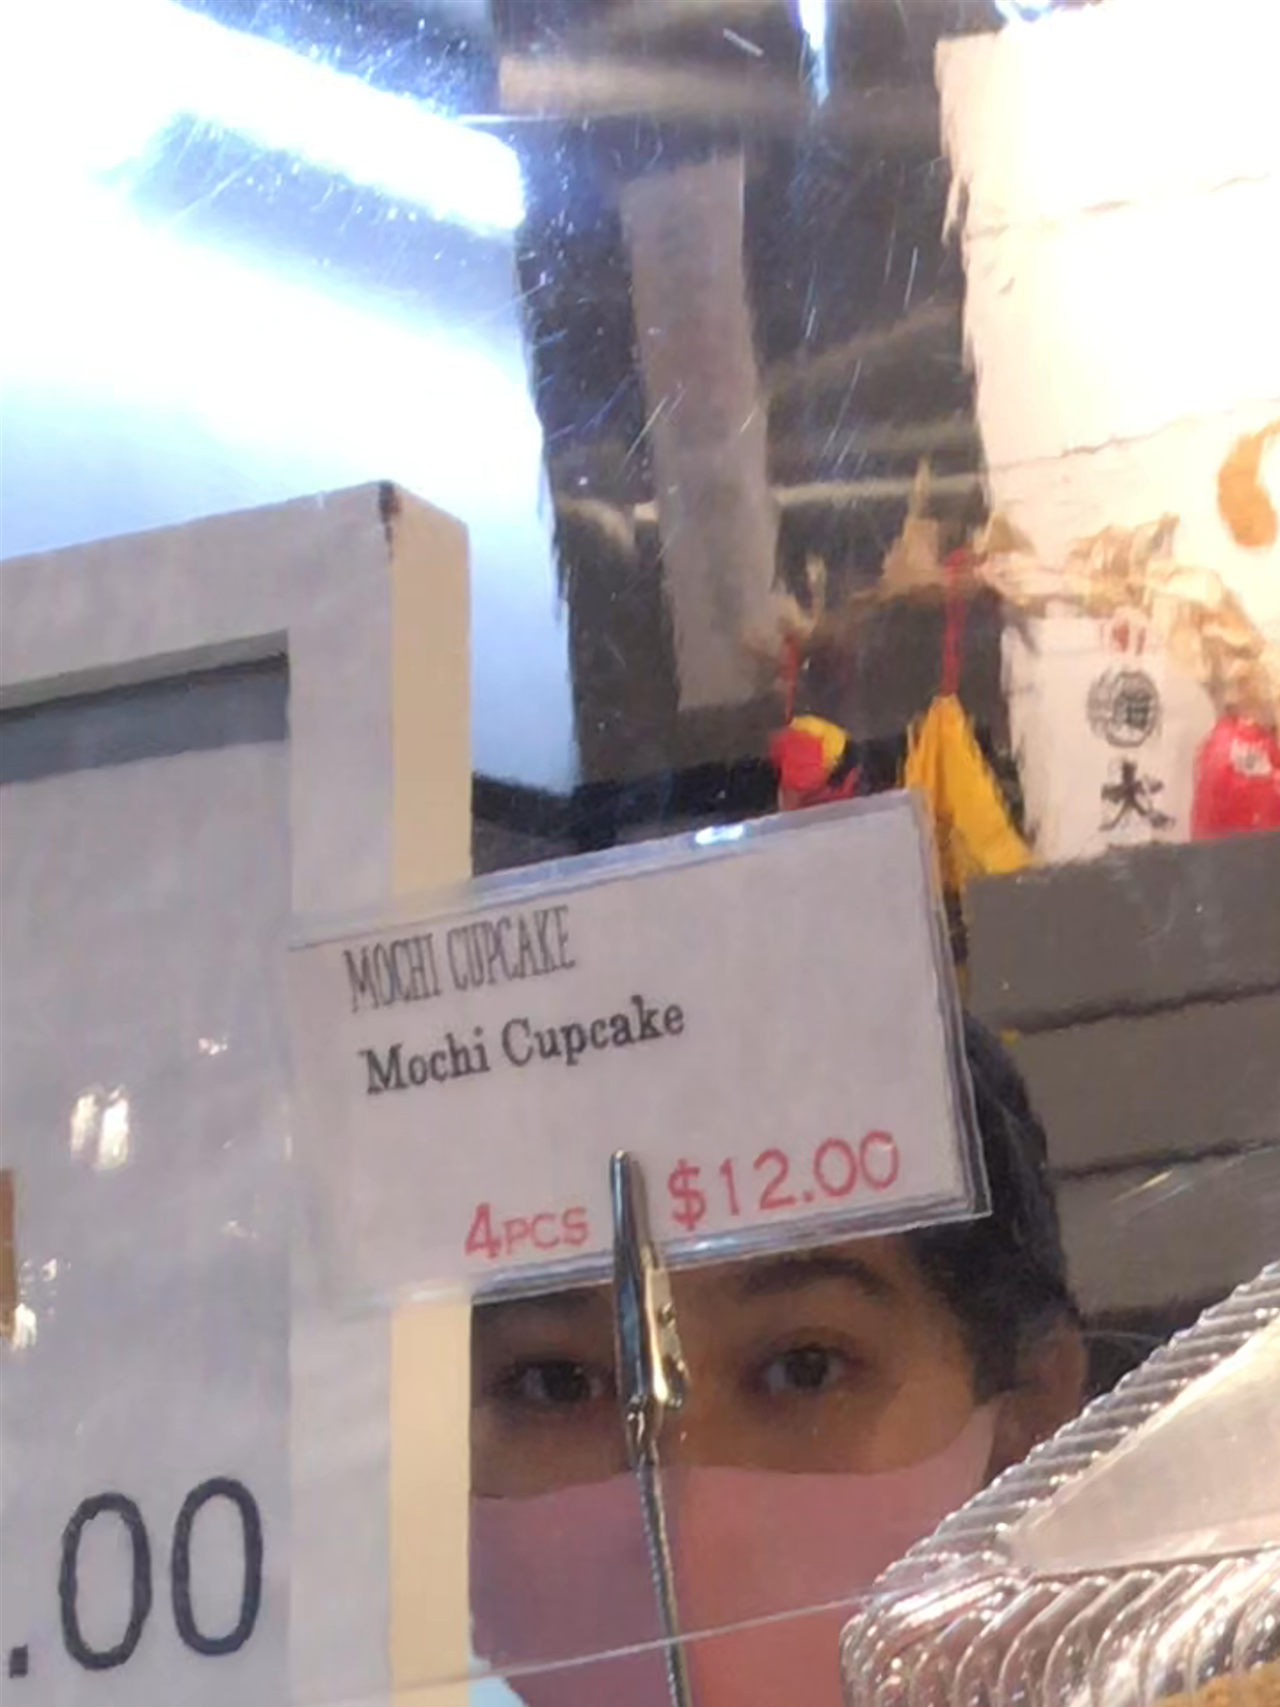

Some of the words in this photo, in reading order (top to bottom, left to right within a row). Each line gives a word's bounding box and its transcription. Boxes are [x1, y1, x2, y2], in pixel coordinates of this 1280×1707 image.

[344, 934, 441, 1013] MOCHI
[447, 905, 577, 993] CUPCAKE
[359, 1026, 491, 1094] Mochi
[502, 995, 685, 1068] Cupcake
[667, 1130, 900, 1231] $12.00
